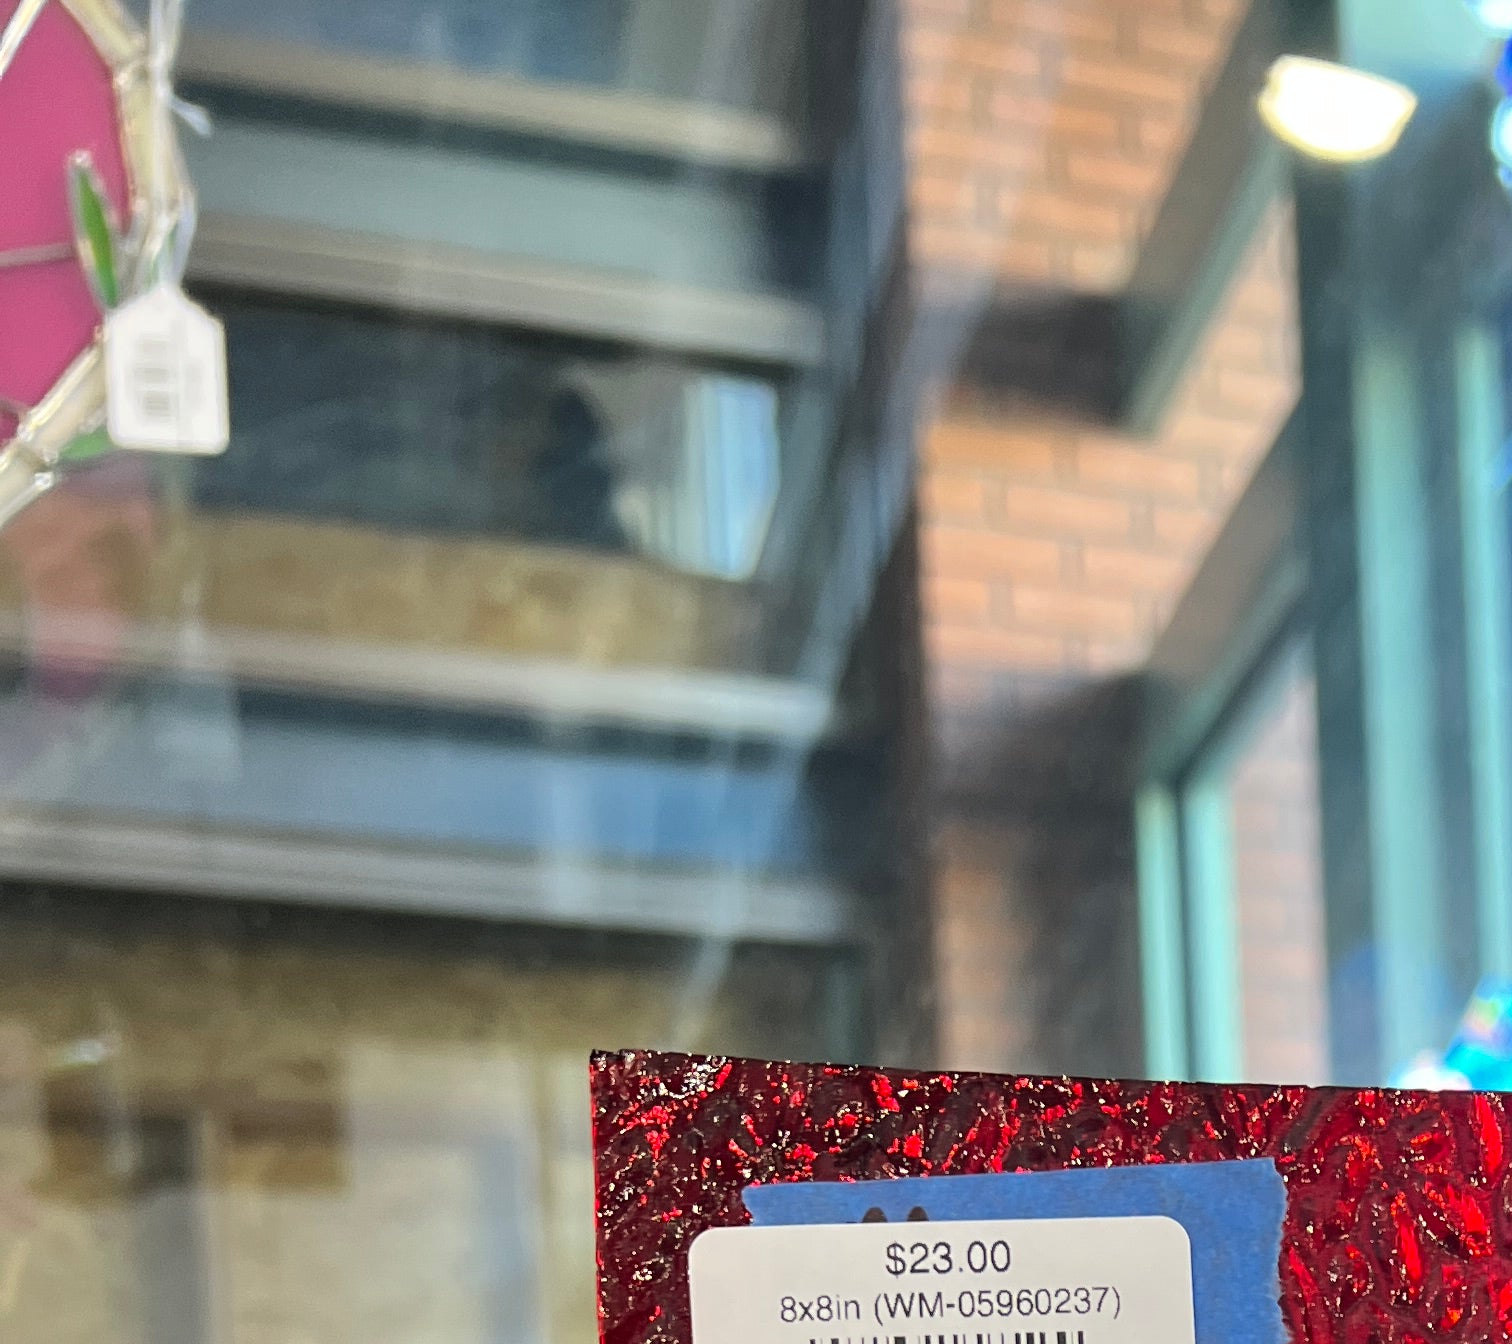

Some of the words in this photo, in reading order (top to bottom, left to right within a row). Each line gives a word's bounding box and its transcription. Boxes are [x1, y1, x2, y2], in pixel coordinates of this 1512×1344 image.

[885, 1240, 1011, 1277] $23.00
[780, 1295, 861, 1323] 8x8in
[874, 1286, 1121, 1327] (WM-05960237)
